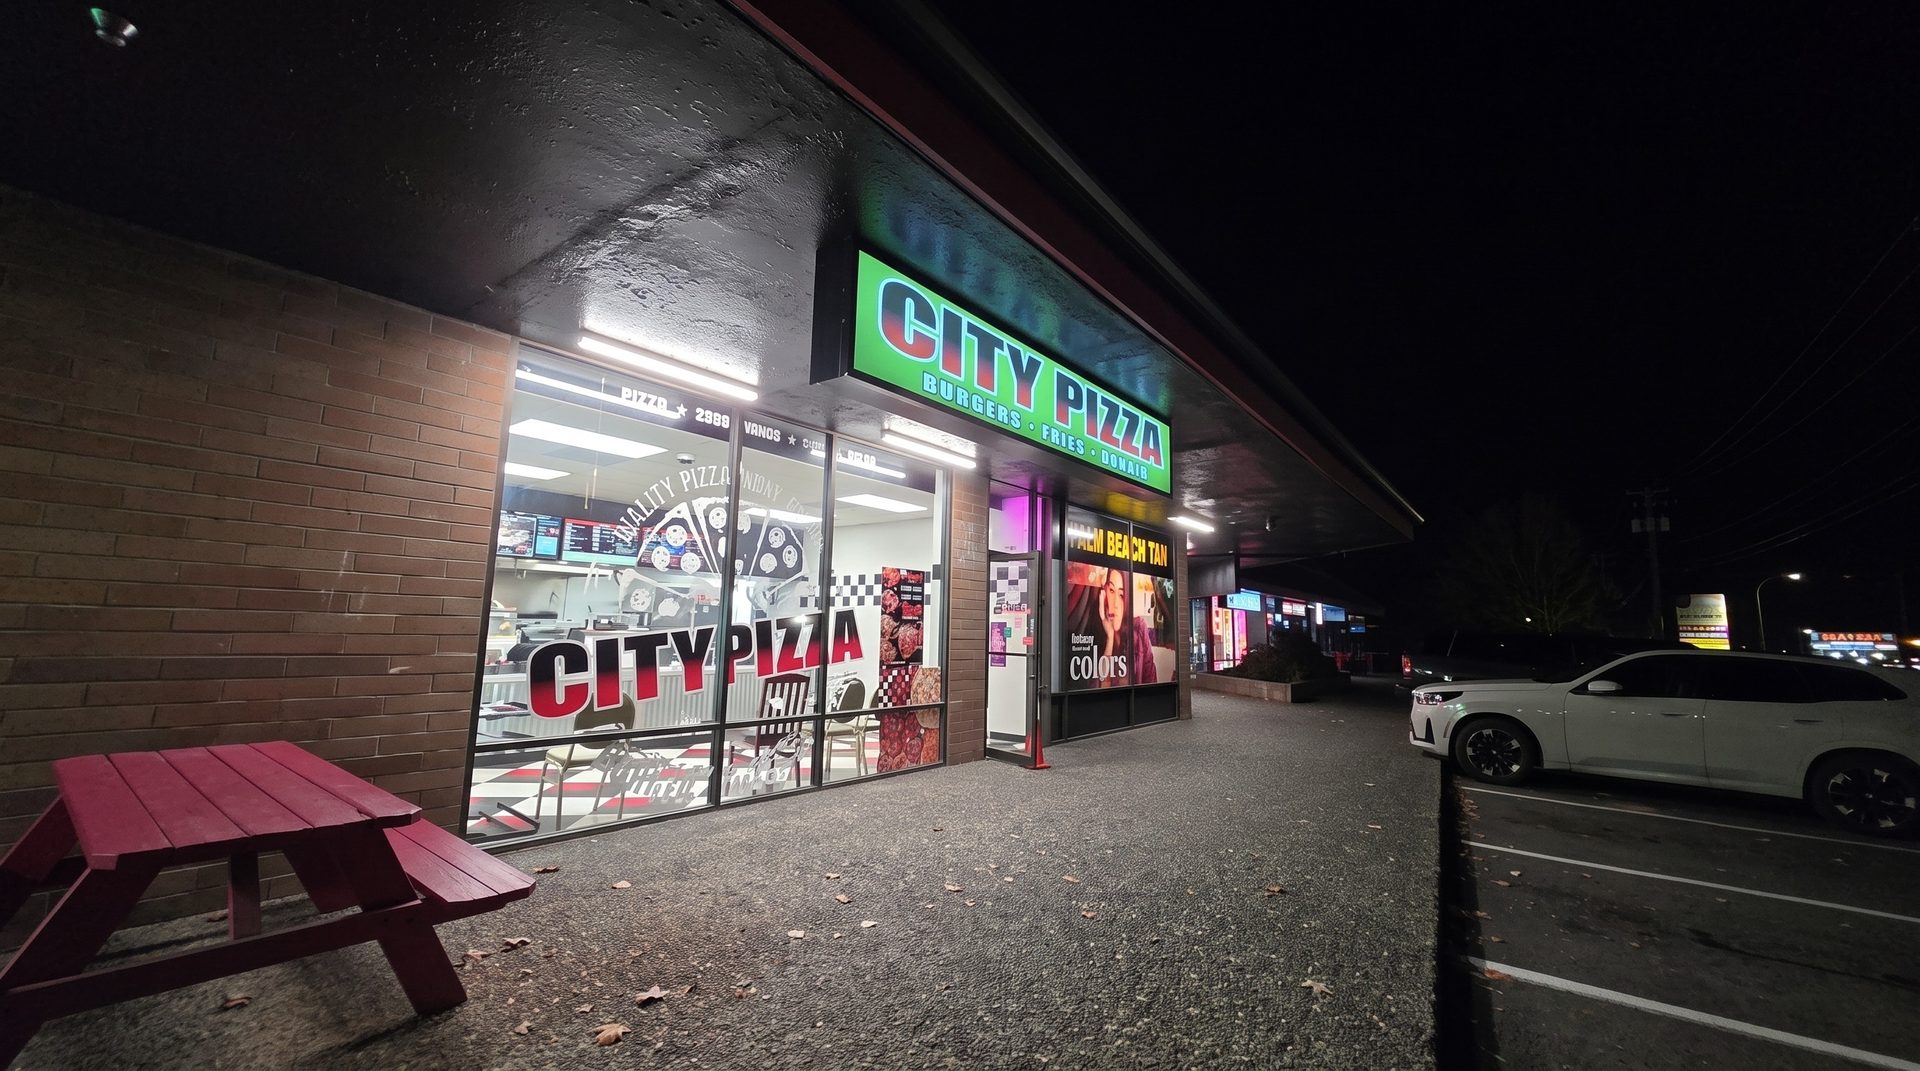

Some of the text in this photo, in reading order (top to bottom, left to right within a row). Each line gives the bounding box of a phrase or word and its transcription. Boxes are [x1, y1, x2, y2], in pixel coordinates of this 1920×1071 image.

[878, 277, 1164, 469] CITY PIZZA
[621, 386, 668, 410] PIZZA
[922, 370, 1021, 430] BURGERS
[1041, 424, 1085, 457] FRIES
[679, 465, 731, 492] PIZZA
[1107, 530, 1146, 563] BEACH
[1148, 540, 1168, 567] TAN
[528, 607, 864, 719] CITY PIZZA
[1069, 645, 1127, 681] colors
